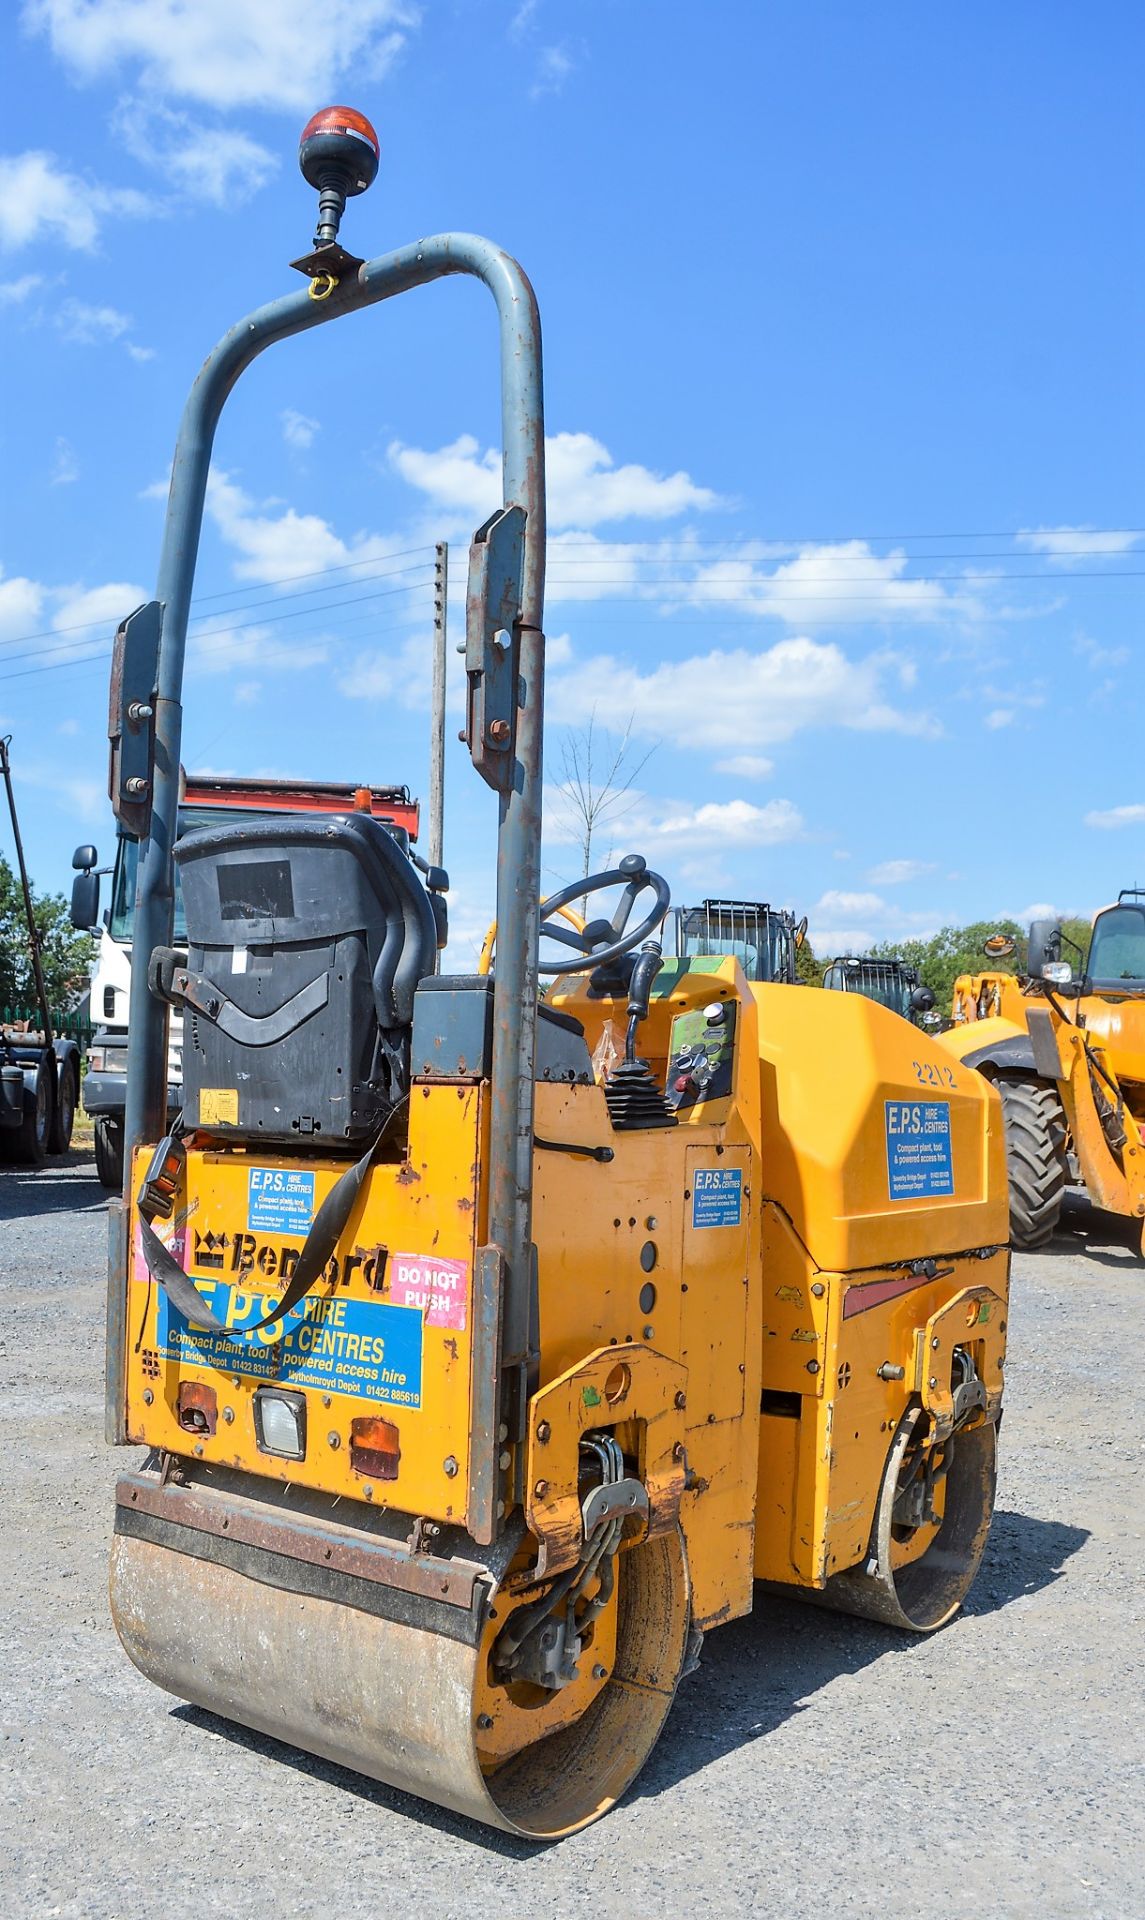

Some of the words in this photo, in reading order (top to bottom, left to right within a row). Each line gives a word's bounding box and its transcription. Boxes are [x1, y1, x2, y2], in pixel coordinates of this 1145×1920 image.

[912, 1061, 957, 1088] 2212
[889, 1106, 923, 1134] E.P.S.
[925, 1108, 938, 1120] HIRE
[925, 1121, 949, 1134] CENTRES
[250, 1171, 285, 1192] E.P.S.
[695, 1172, 721, 1190] E.P.S.
[231, 1233, 389, 1291] Benord
[398, 1265, 420, 1284] DO
[424, 1270, 460, 1290] NOT
[188, 1280, 293, 1347] EP.S.
[303, 1297, 347, 1327] HIRE
[405, 1290, 450, 1312] PUSH
[168, 1329, 214, 1350] Compact
[215, 1339, 245, 1357] plant,
[248, 1345, 270, 1360] tool
[283, 1353, 334, 1372] powered
[335, 1363, 379, 1380] access
[381, 1368, 407, 1386] hire
[298, 1325, 385, 1365] CENTRES
[158, 1345, 184, 1361] Sowerby
[186, 1350, 206, 1365] Bridge
[207, 1355, 228, 1368] Depot
[231, 1360, 252, 1372] 01422
[288, 1370, 336, 1389] Mytholmroyd
[338, 1379, 361, 1394] Depot
[366, 1385, 390, 1398] 01422
